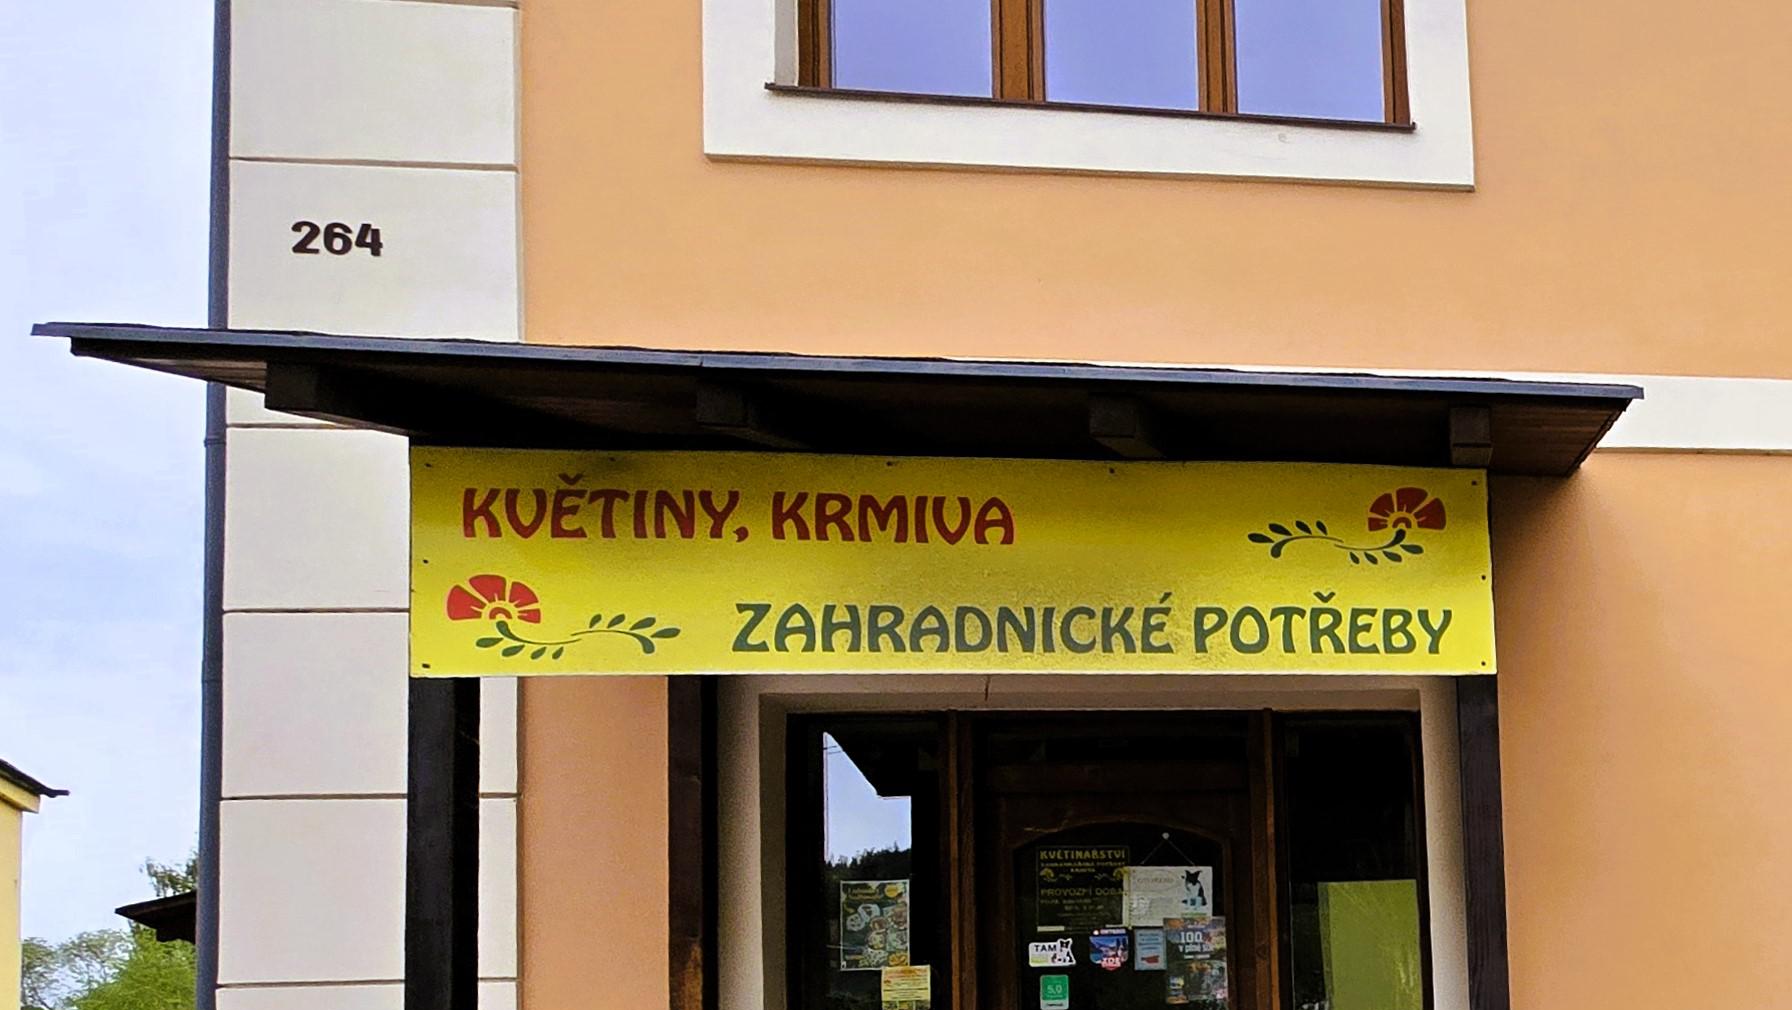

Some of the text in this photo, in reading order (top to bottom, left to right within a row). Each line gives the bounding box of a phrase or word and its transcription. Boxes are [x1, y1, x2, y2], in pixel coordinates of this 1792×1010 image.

[291, 220, 384, 257] 264
[462, 473, 1016, 545] KVĚTINY, KRMIVA
[732, 592, 1455, 656] ZAHRADNICKÉ POTŘEBY
